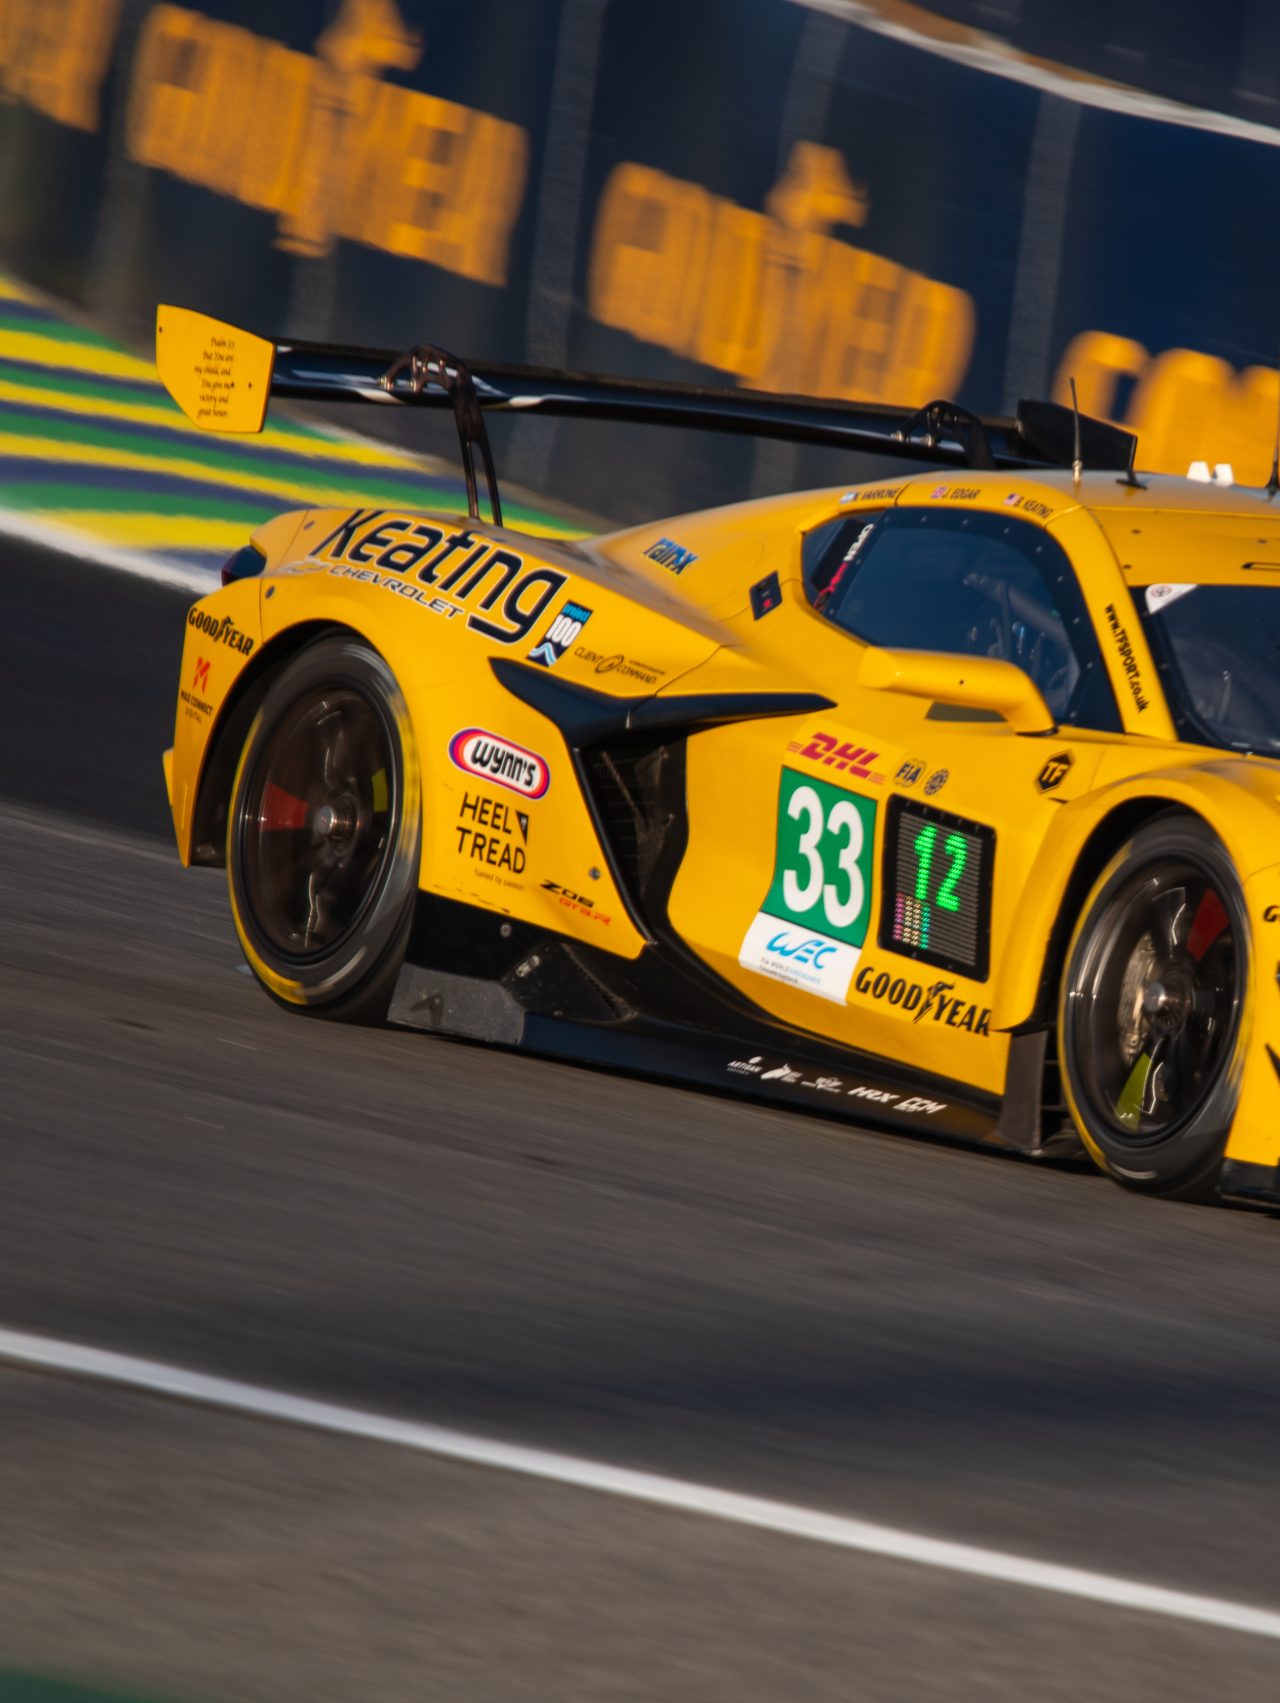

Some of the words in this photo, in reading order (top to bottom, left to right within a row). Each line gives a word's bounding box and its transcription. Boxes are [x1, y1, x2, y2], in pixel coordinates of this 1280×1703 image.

[950, 488, 981, 500] EDGAR
[306, 508, 569, 645] Keating
[328, 563, 465, 619] CHEVROLET
[188, 605, 255, 657] GOODYEAR
[544, 613, 582, 647] 100
[574, 646, 604, 665] CLIENT
[616, 663, 658, 685] COMMAND
[1104, 602, 1150, 715] www.TFSPORT.co.uk
[190, 694, 214, 716] CONNECT
[799, 731, 881, 779] DHL
[896, 761, 923, 785] FIA
[1041, 761, 1069, 784] TF
[459, 791, 513, 835] HEEL
[456, 825, 526, 875] TREAD
[782, 786, 864, 928] 33
[913, 821, 969, 913] 12
[538, 878, 596, 908] Z06
[765, 931, 838, 970] WEC
[770, 960, 790, 973] WORLD
[855, 965, 993, 1038] GOODYEAR
